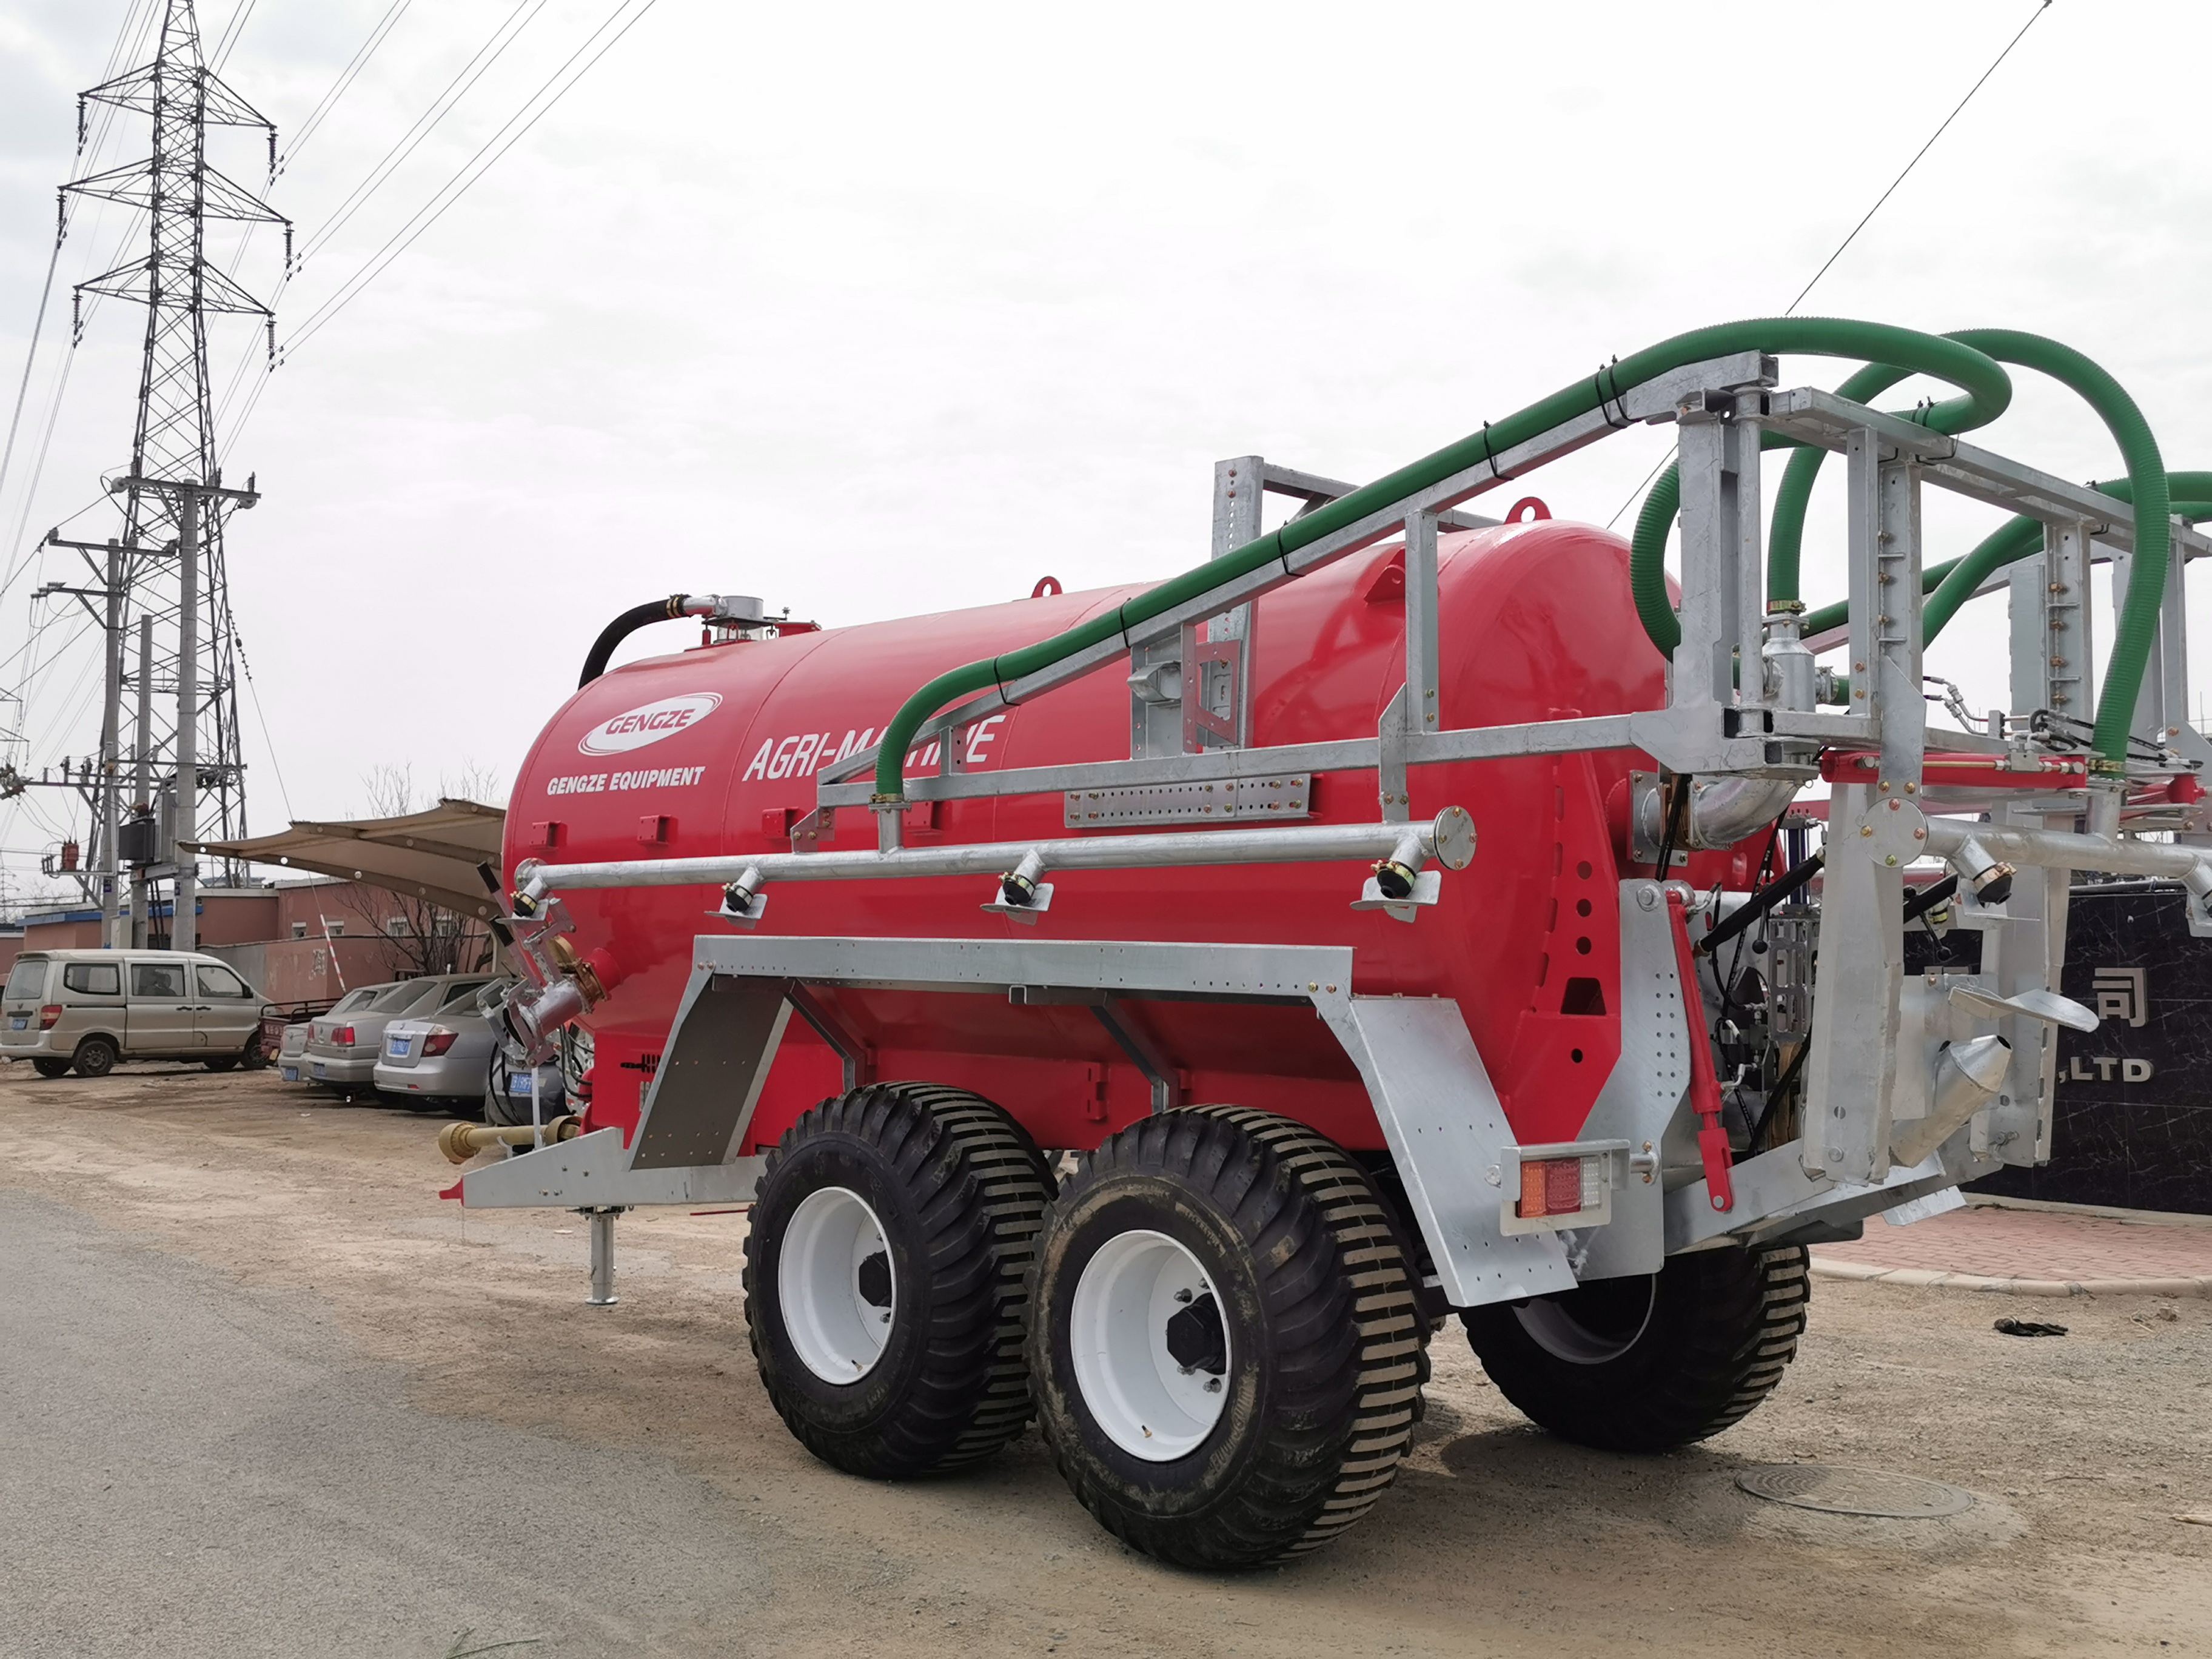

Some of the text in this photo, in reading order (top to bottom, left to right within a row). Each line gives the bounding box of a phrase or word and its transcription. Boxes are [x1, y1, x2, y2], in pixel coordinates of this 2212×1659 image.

[605, 708, 696, 736] GENGZE
[547, 766, 706, 796] GENGZE EQUIPMENT
[2092, 967, 2148, 1028] 司
